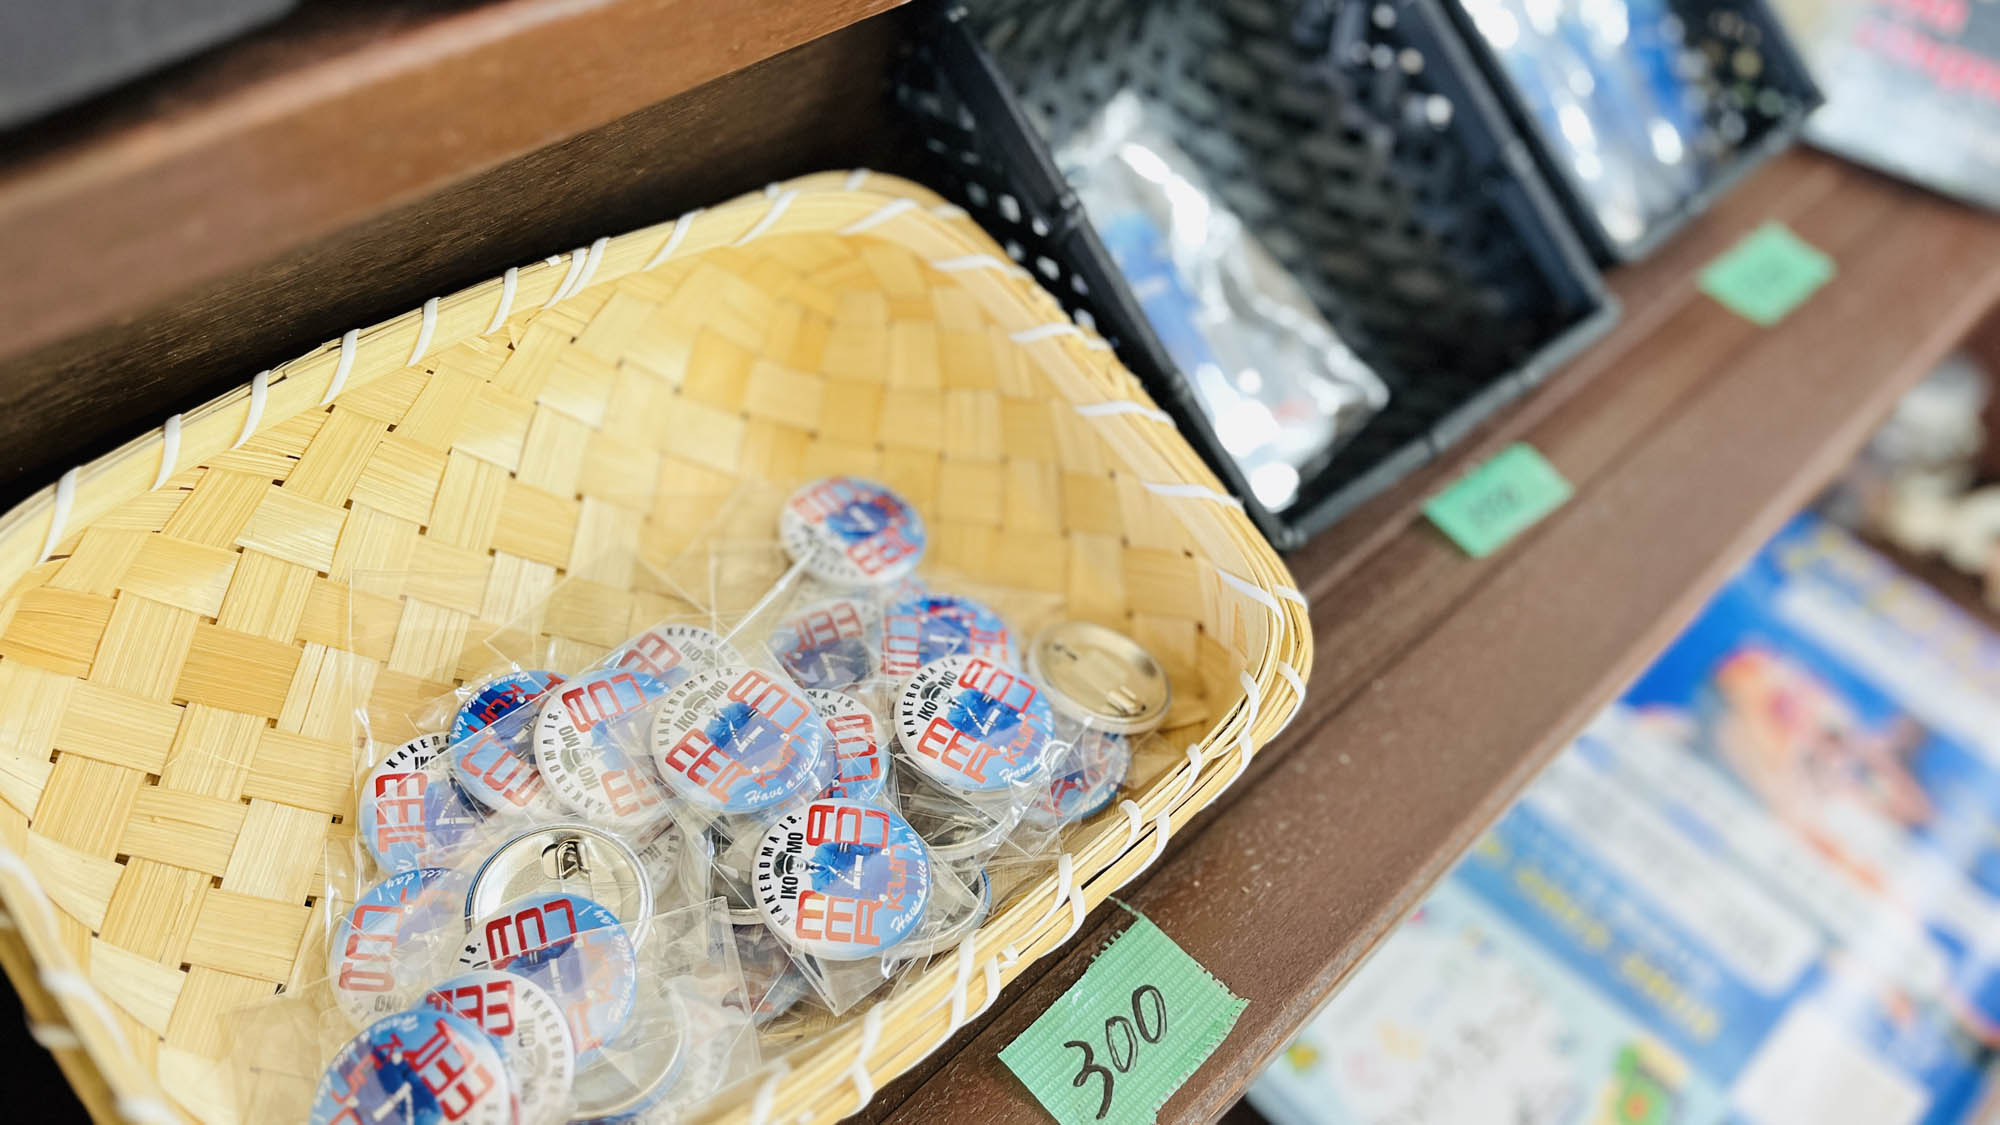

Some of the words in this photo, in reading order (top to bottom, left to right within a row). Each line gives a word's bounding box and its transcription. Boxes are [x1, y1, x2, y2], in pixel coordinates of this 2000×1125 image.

[657, 674, 708, 746] KAKEROMA
[902, 667, 936, 738] KAKEROMA
[744, 786, 785, 805] Have
[759, 836, 791, 926] KAKEROMA
[779, 815, 802, 831] IS.
[890, 900, 920, 933] Have
[1064, 985, 1167, 1120] 300
